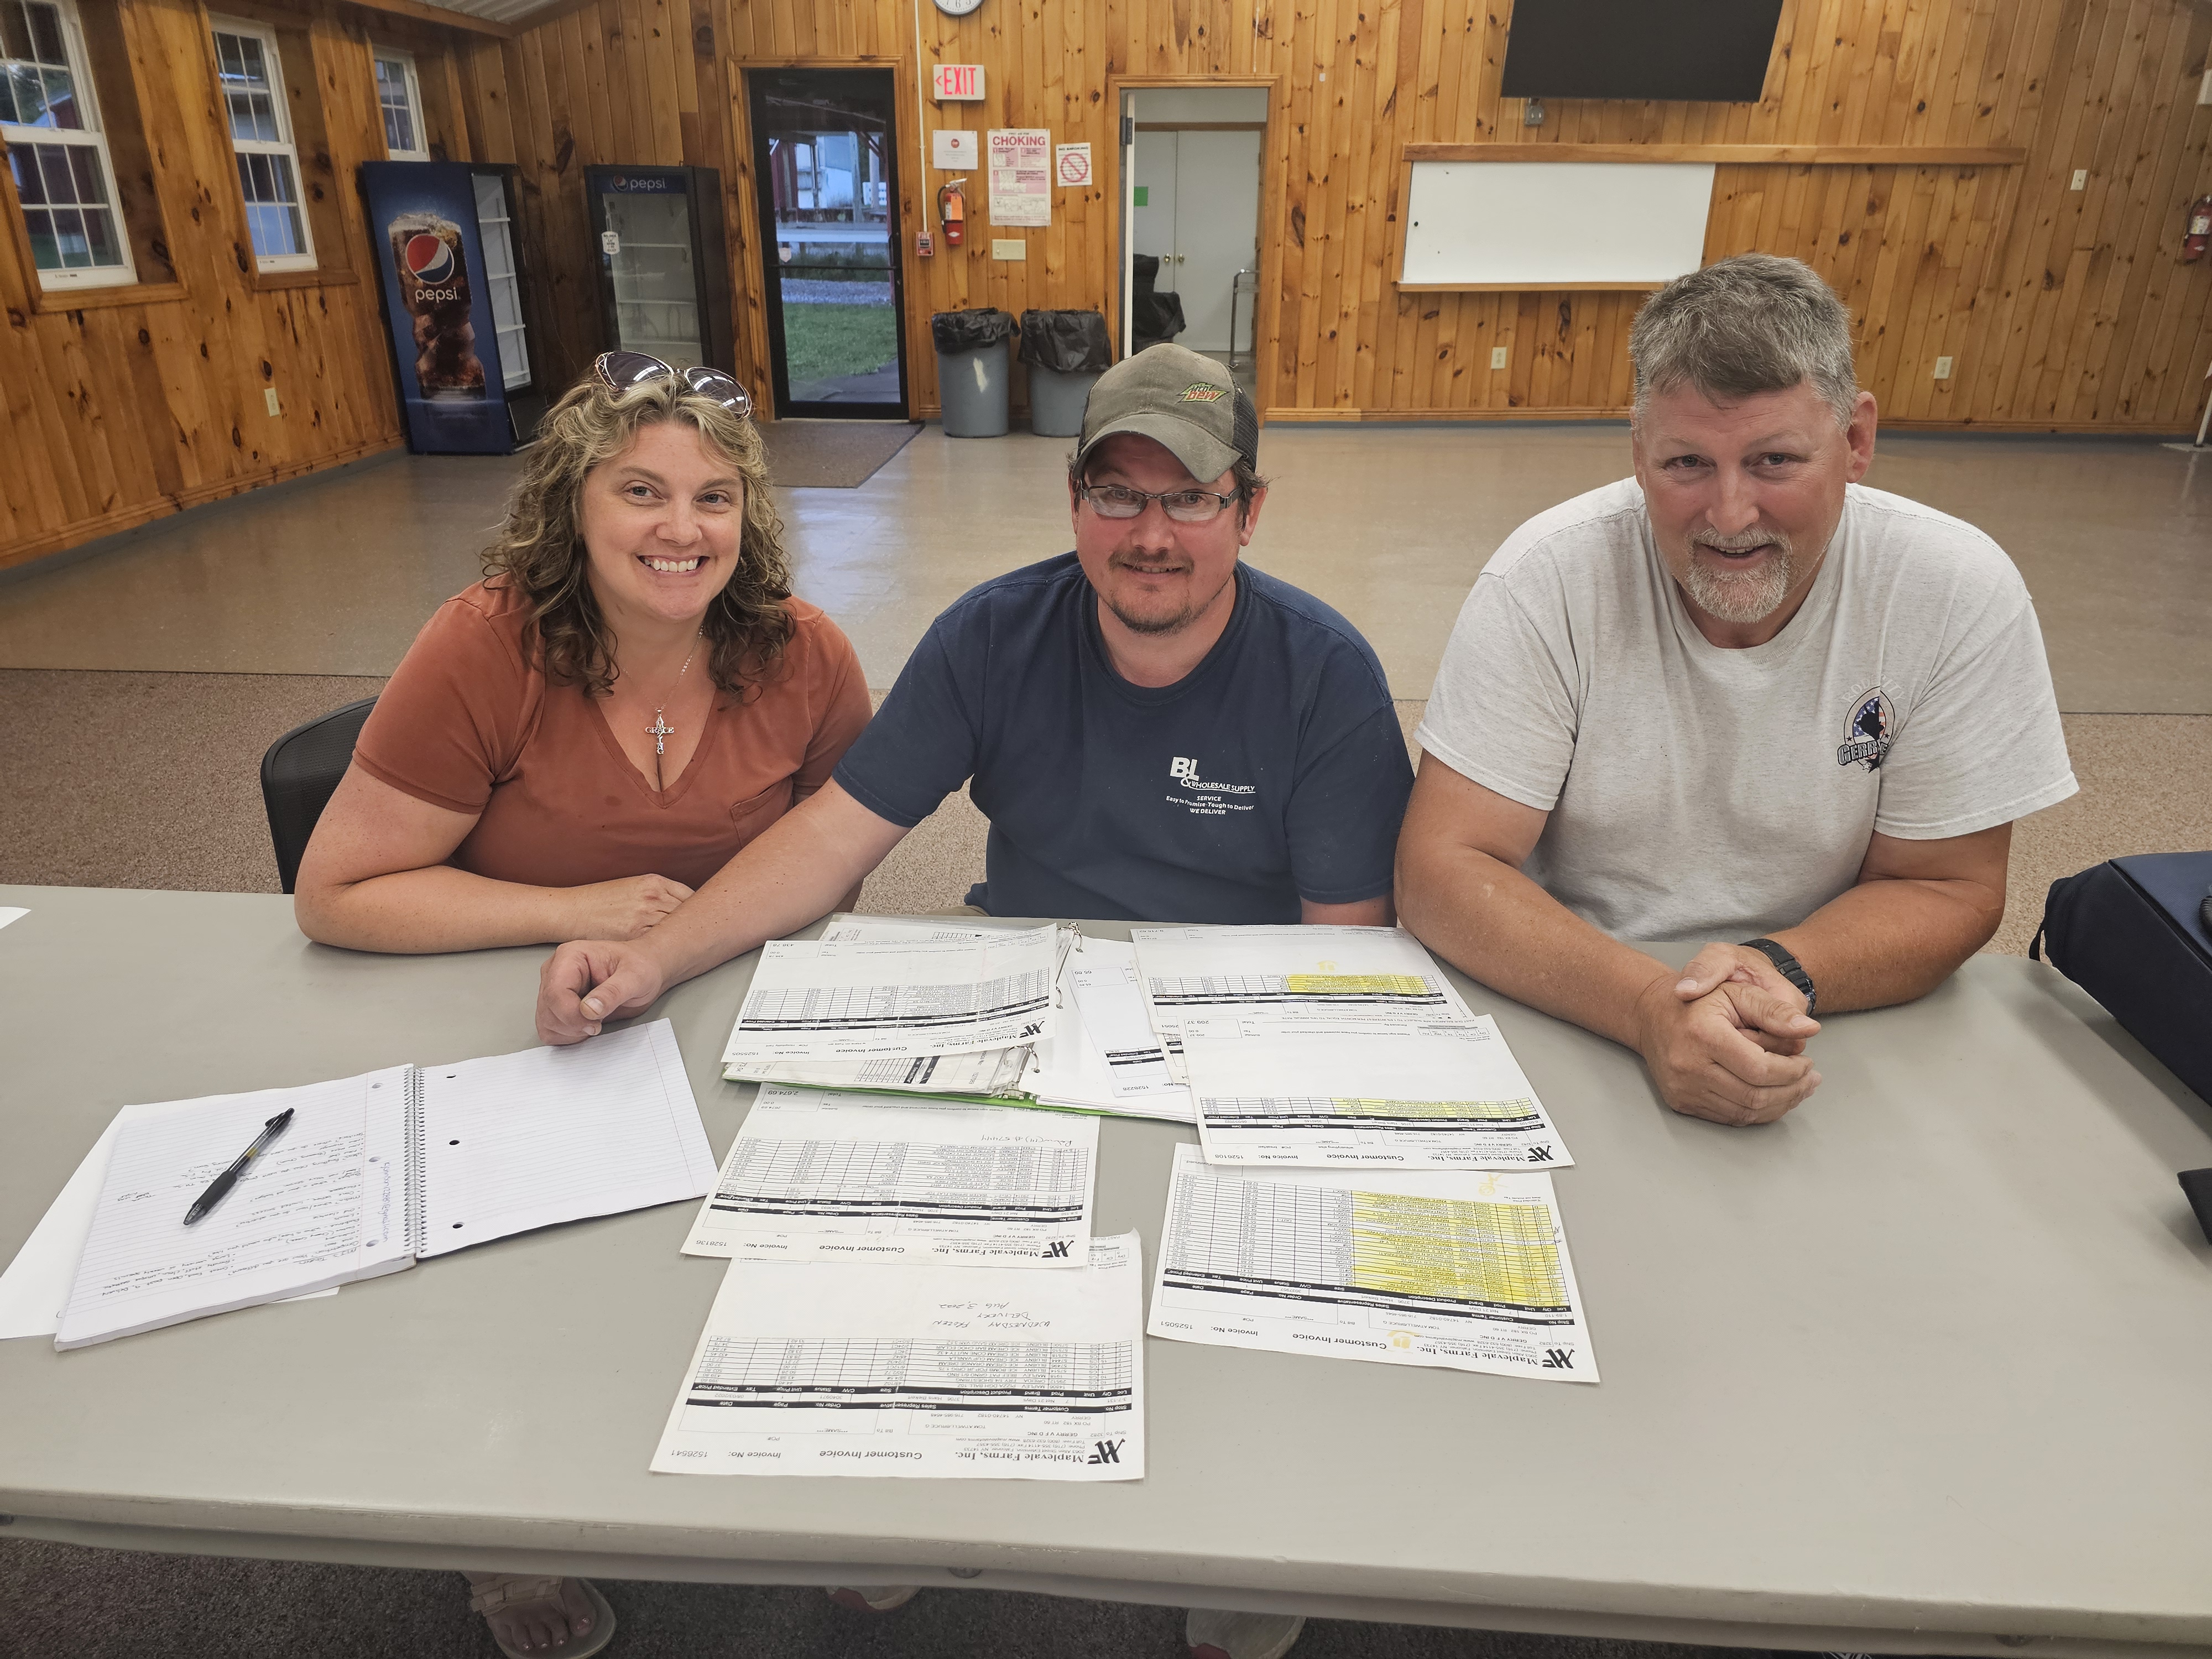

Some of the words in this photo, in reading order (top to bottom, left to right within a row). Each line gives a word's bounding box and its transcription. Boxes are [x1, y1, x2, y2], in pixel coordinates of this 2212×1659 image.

[943, 67, 977, 95] EXIT
[993, 136, 1045, 146] CHOKING
[630, 178, 666, 191] pepsi
[415, 287, 458, 303] pepsi
[1191, 781, 1230, 790] WHOLESALE
[977, 1035, 1016, 1044] Maplevale
[857, 1245, 905, 1254] Customer
[977, 1312, 1031, 1320] DELIVERY
[1161, 1321, 1193, 1329] 1525051
[1228, 1328, 1258, 1336] Invoice
[1292, 1333, 1331, 1344] Invoice
[1334, 1337, 1386, 1350] Customer
[1440, 1348, 1478, 1359] Farms,
[1481, 1353, 1538, 1365] Maplevale
[820, 1451, 862, 1459] Invoice
[864, 1452, 922, 1460] Customer
[980, 1451, 1020, 1460] Farms,
[1024, 1453, 1084, 1462] Maplevale
